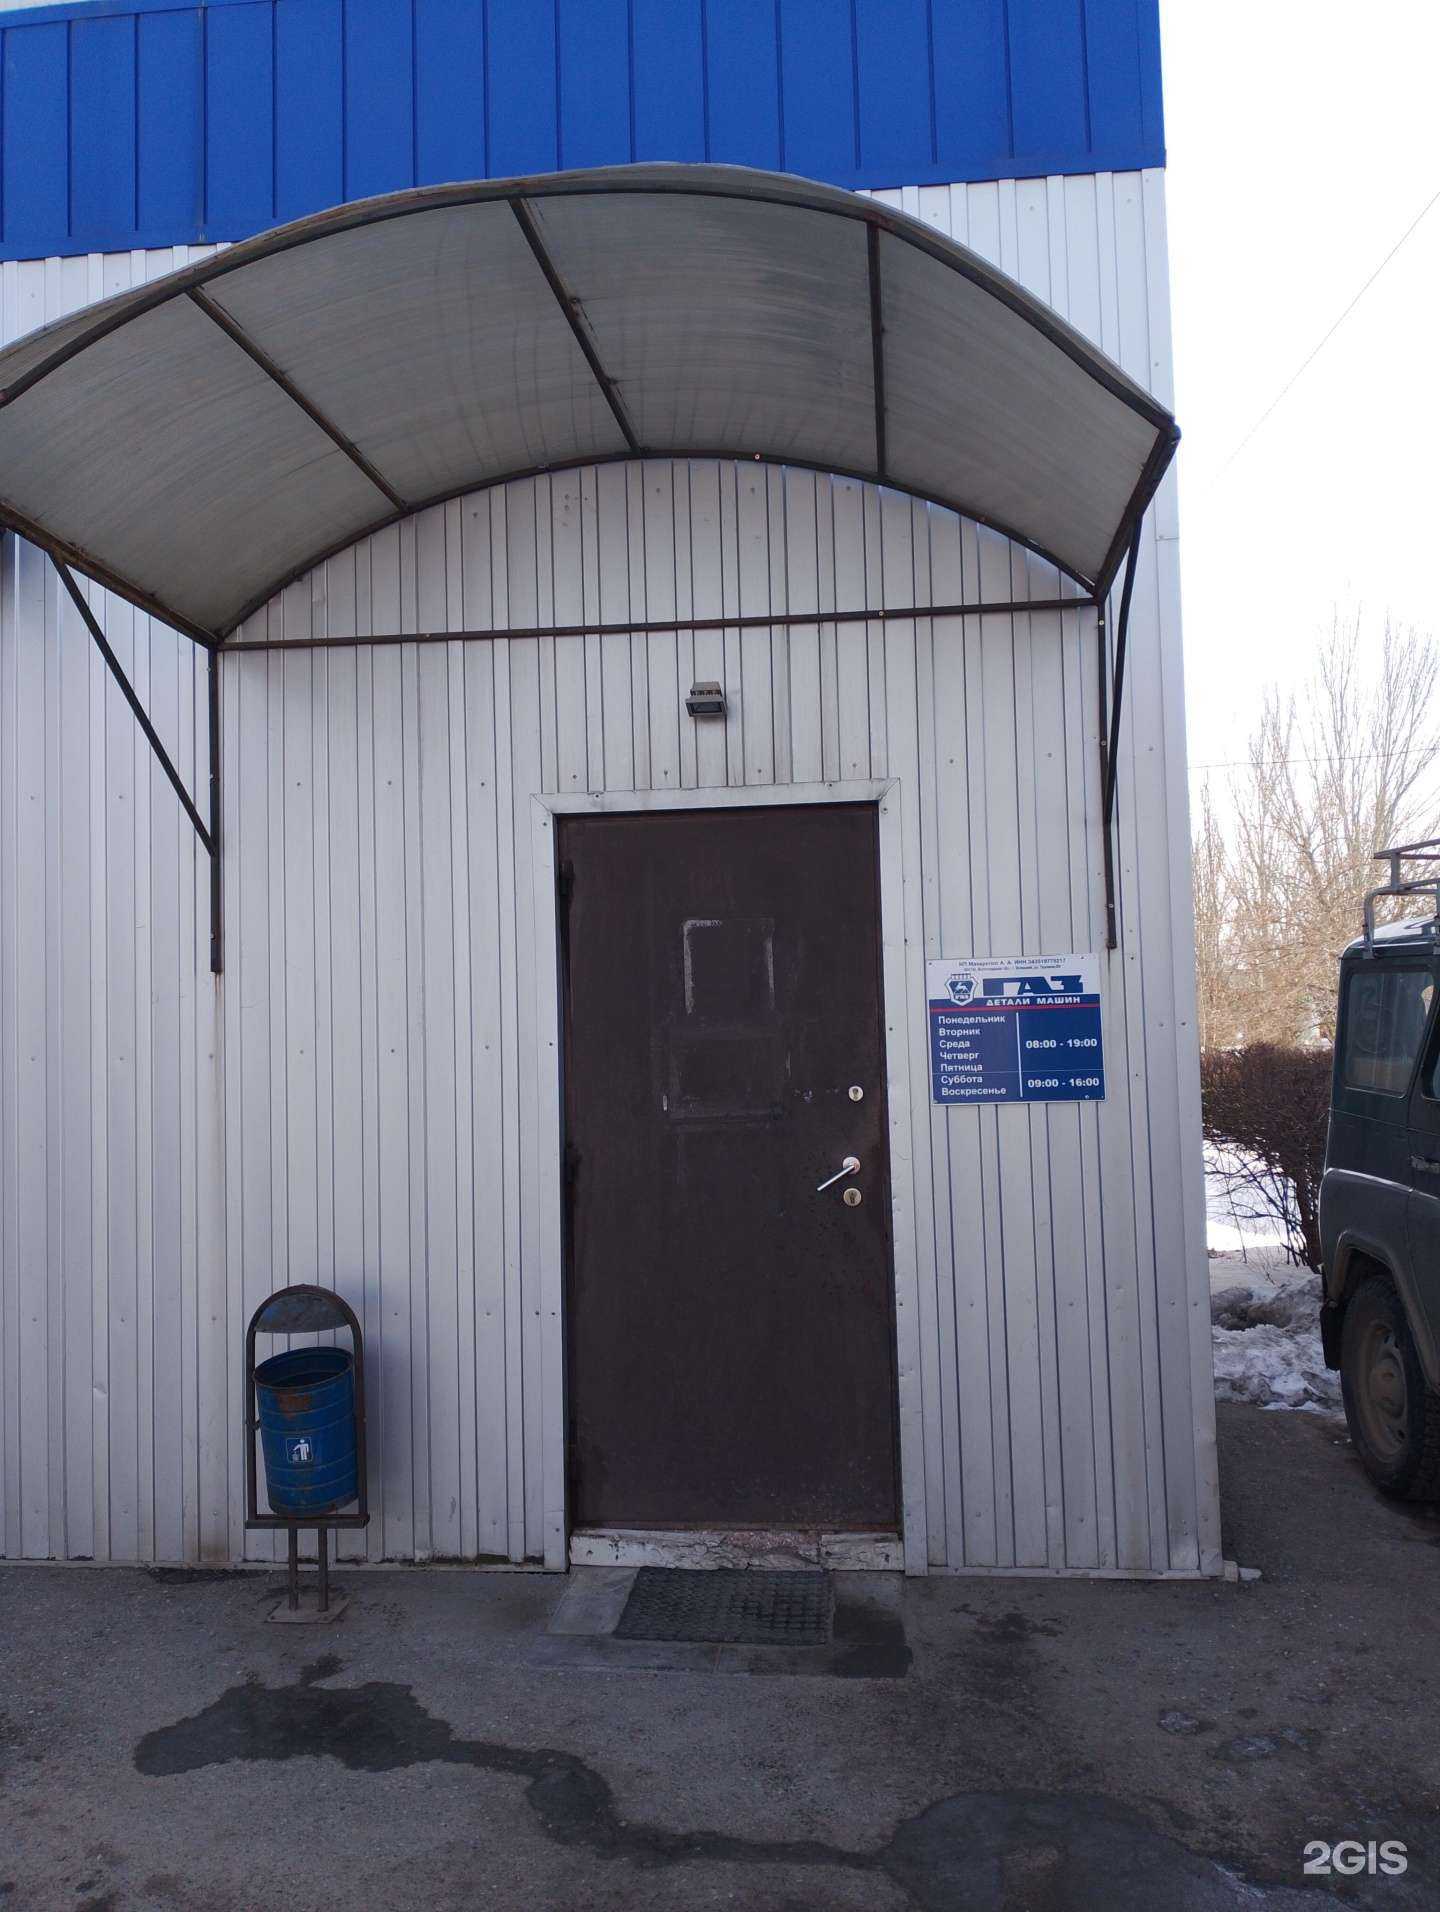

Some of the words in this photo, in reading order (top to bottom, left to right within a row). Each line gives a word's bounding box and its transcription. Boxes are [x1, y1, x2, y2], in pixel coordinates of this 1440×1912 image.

[983, 975, 1084, 996] ГАЗ
[986, 998, 1031, 1006] ДЕТАЛИ
[1036, 996, 1081, 1005] МАШИН
[938, 1015, 1006, 1025] Понедельник
[938, 1027, 981, 1037] Вторник
[939, 1040, 970, 1049] Среда
[1025, 1039, 1057, 1049] 08:00
[1067, 1038, 1098, 1048] 19:00
[940, 1051, 980, 1061] Четверг
[940, 1063, 983, 1073] Пятница
[941, 1075, 983, 1085] Суббота
[1027, 1079, 1059, 1088] 09:00
[1069, 1077, 1100, 1087] 16:00
[941, 1087, 1006, 1097] Воскресенье
